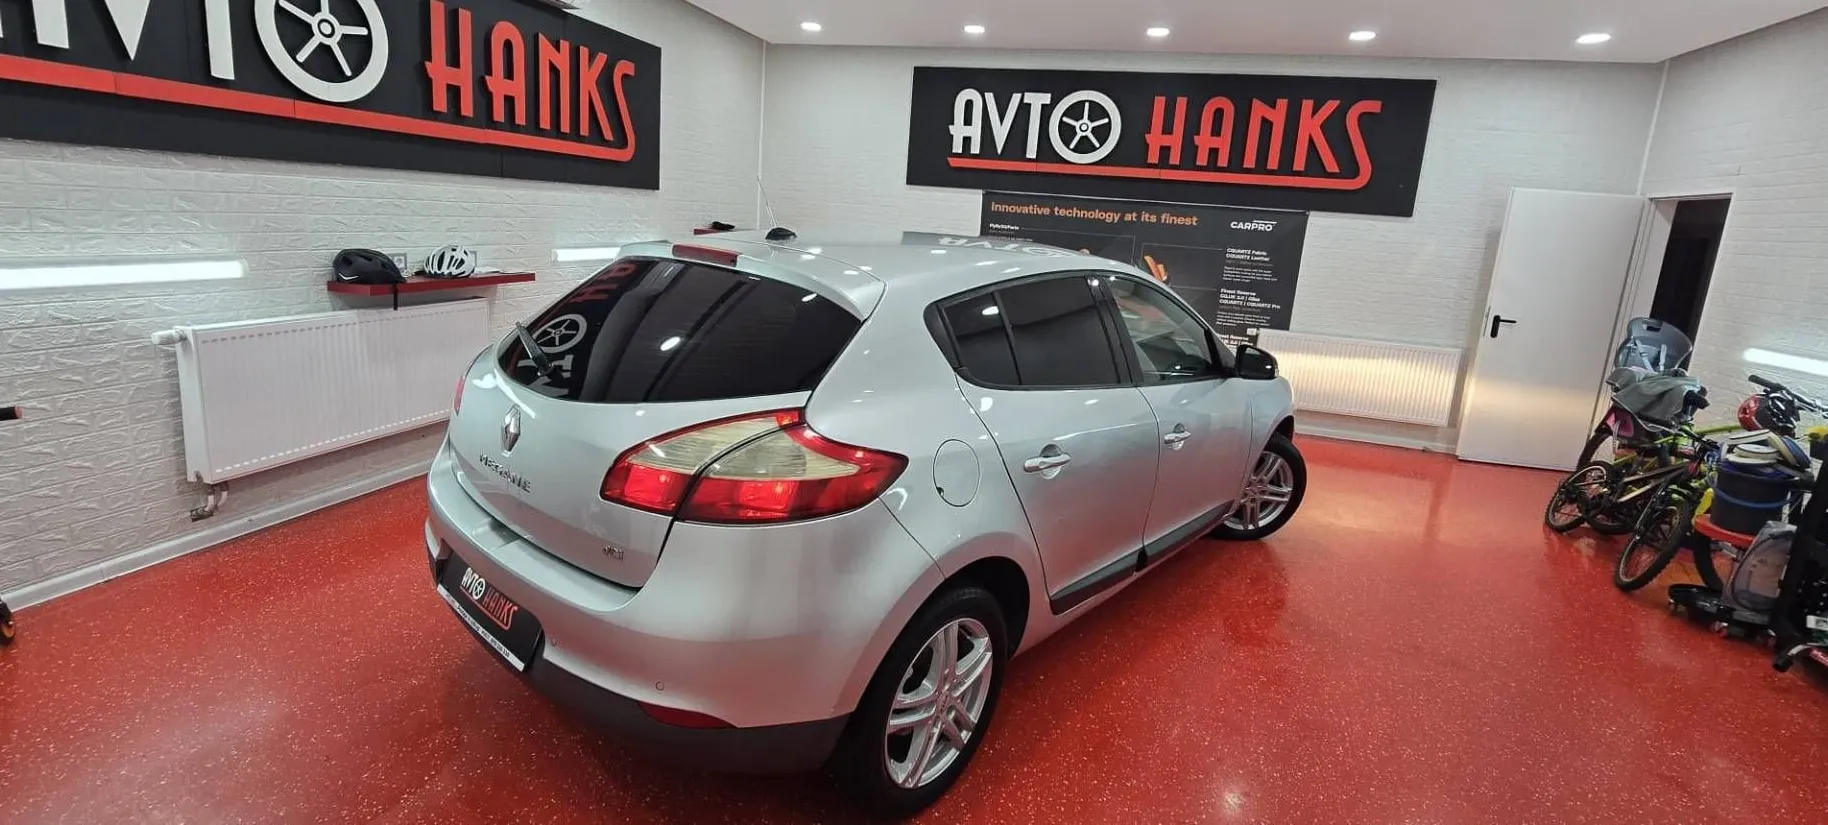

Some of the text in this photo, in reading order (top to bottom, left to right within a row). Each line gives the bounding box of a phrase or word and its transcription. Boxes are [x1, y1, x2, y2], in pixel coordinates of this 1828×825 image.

[424, 0, 635, 162] HANKS
[949, 88, 1382, 190] AVTO HANKS
[991, 201, 1198, 226] Innovative technology at its finest
[1230, 220, 1275, 232] CARPRO
[482, 587, 519, 631] HANKS
